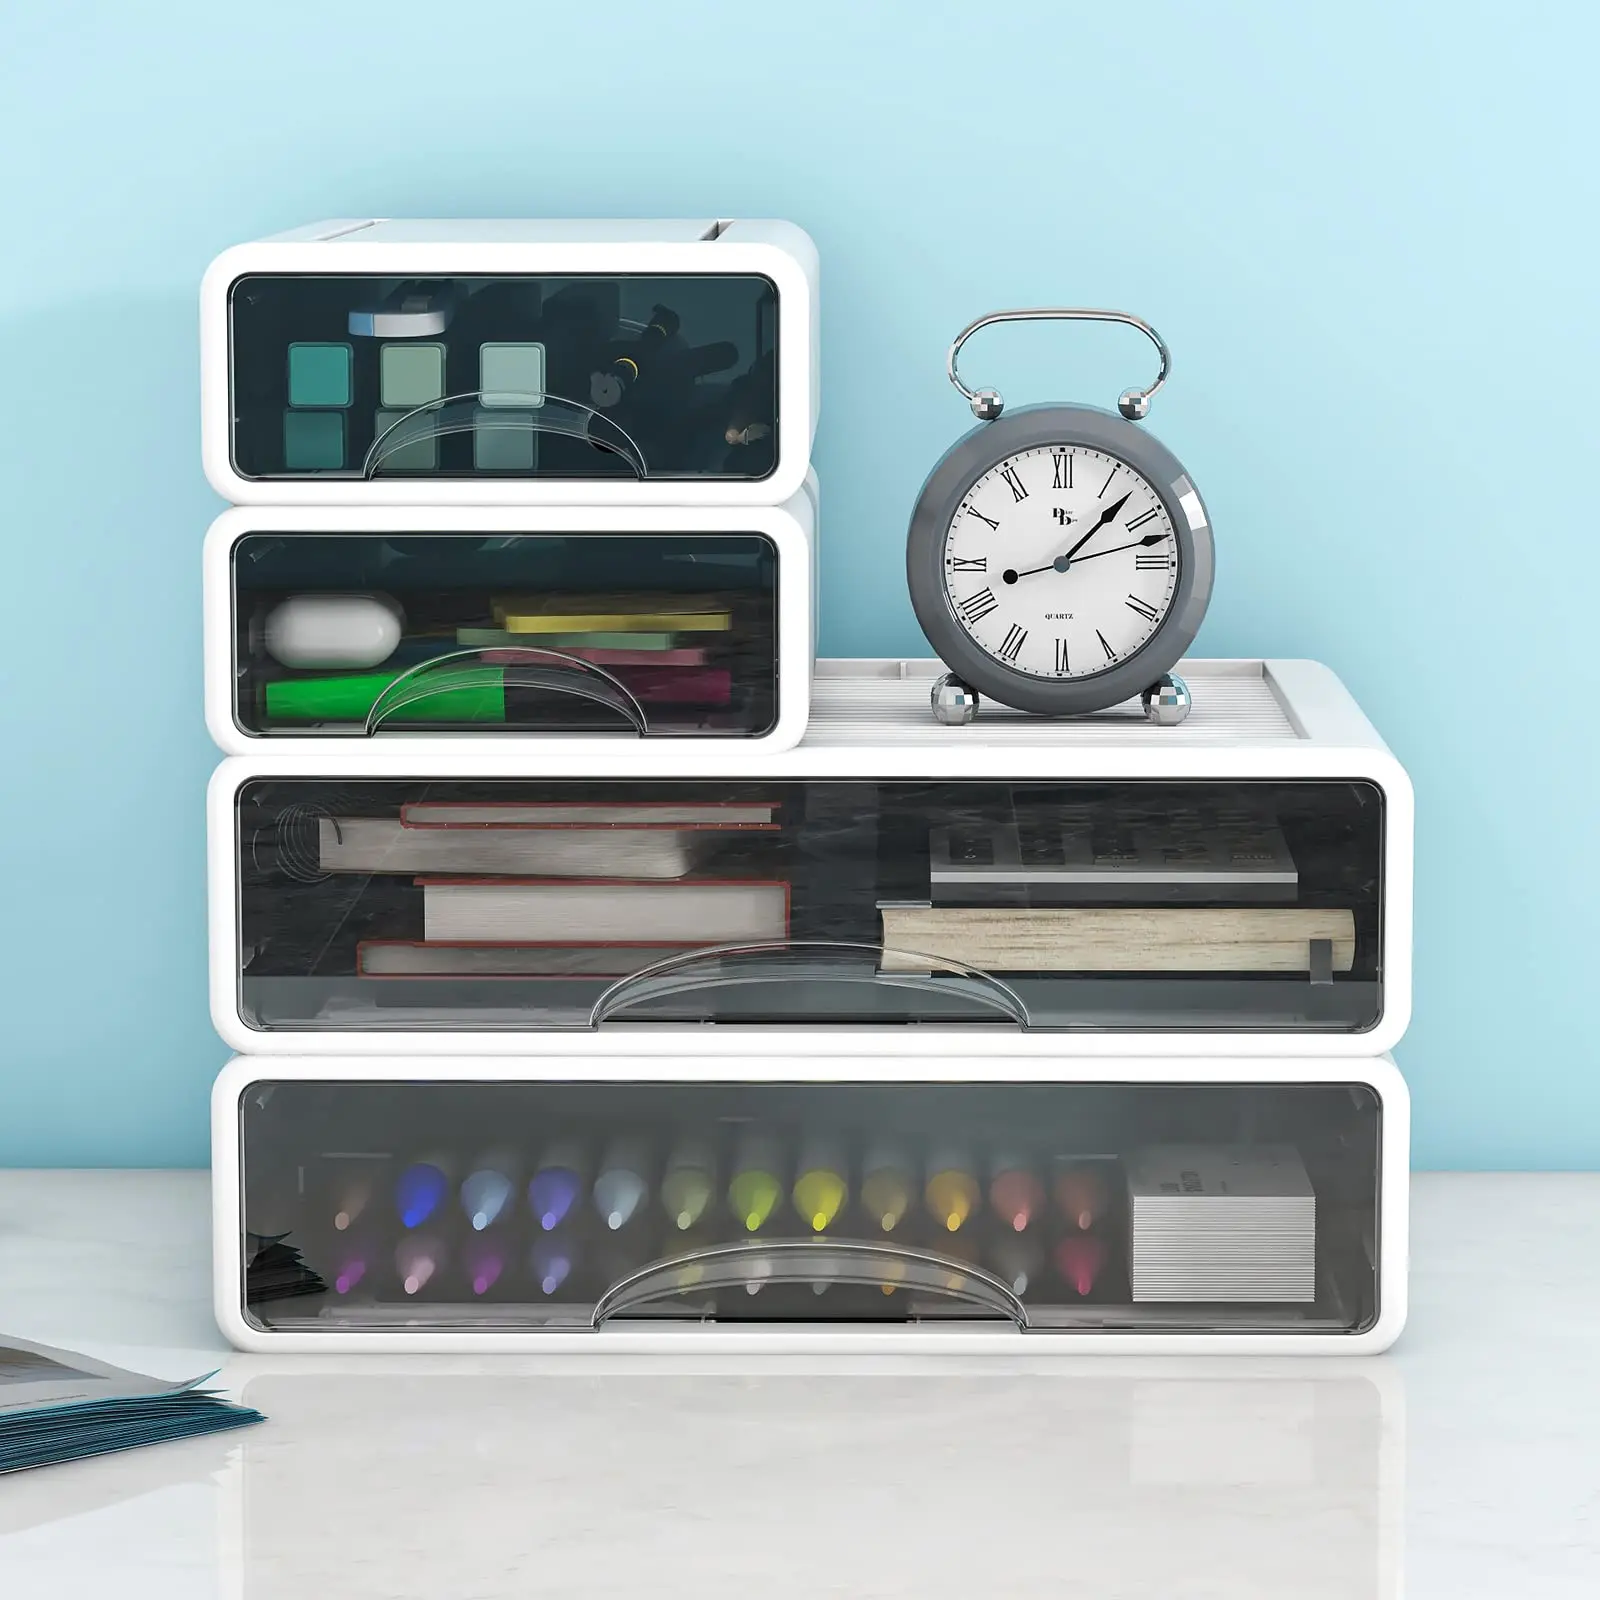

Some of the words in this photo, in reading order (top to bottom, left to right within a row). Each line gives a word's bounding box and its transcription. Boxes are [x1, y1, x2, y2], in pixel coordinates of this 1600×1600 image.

[1052, 454, 1073, 489] XII
[1097, 468, 1117, 498] I
[967, 506, 1000, 531] X
[1125, 508, 1159, 532] II
[1136, 554, 1170, 570] III
[1044, 612, 1074, 621] QUARTZ
